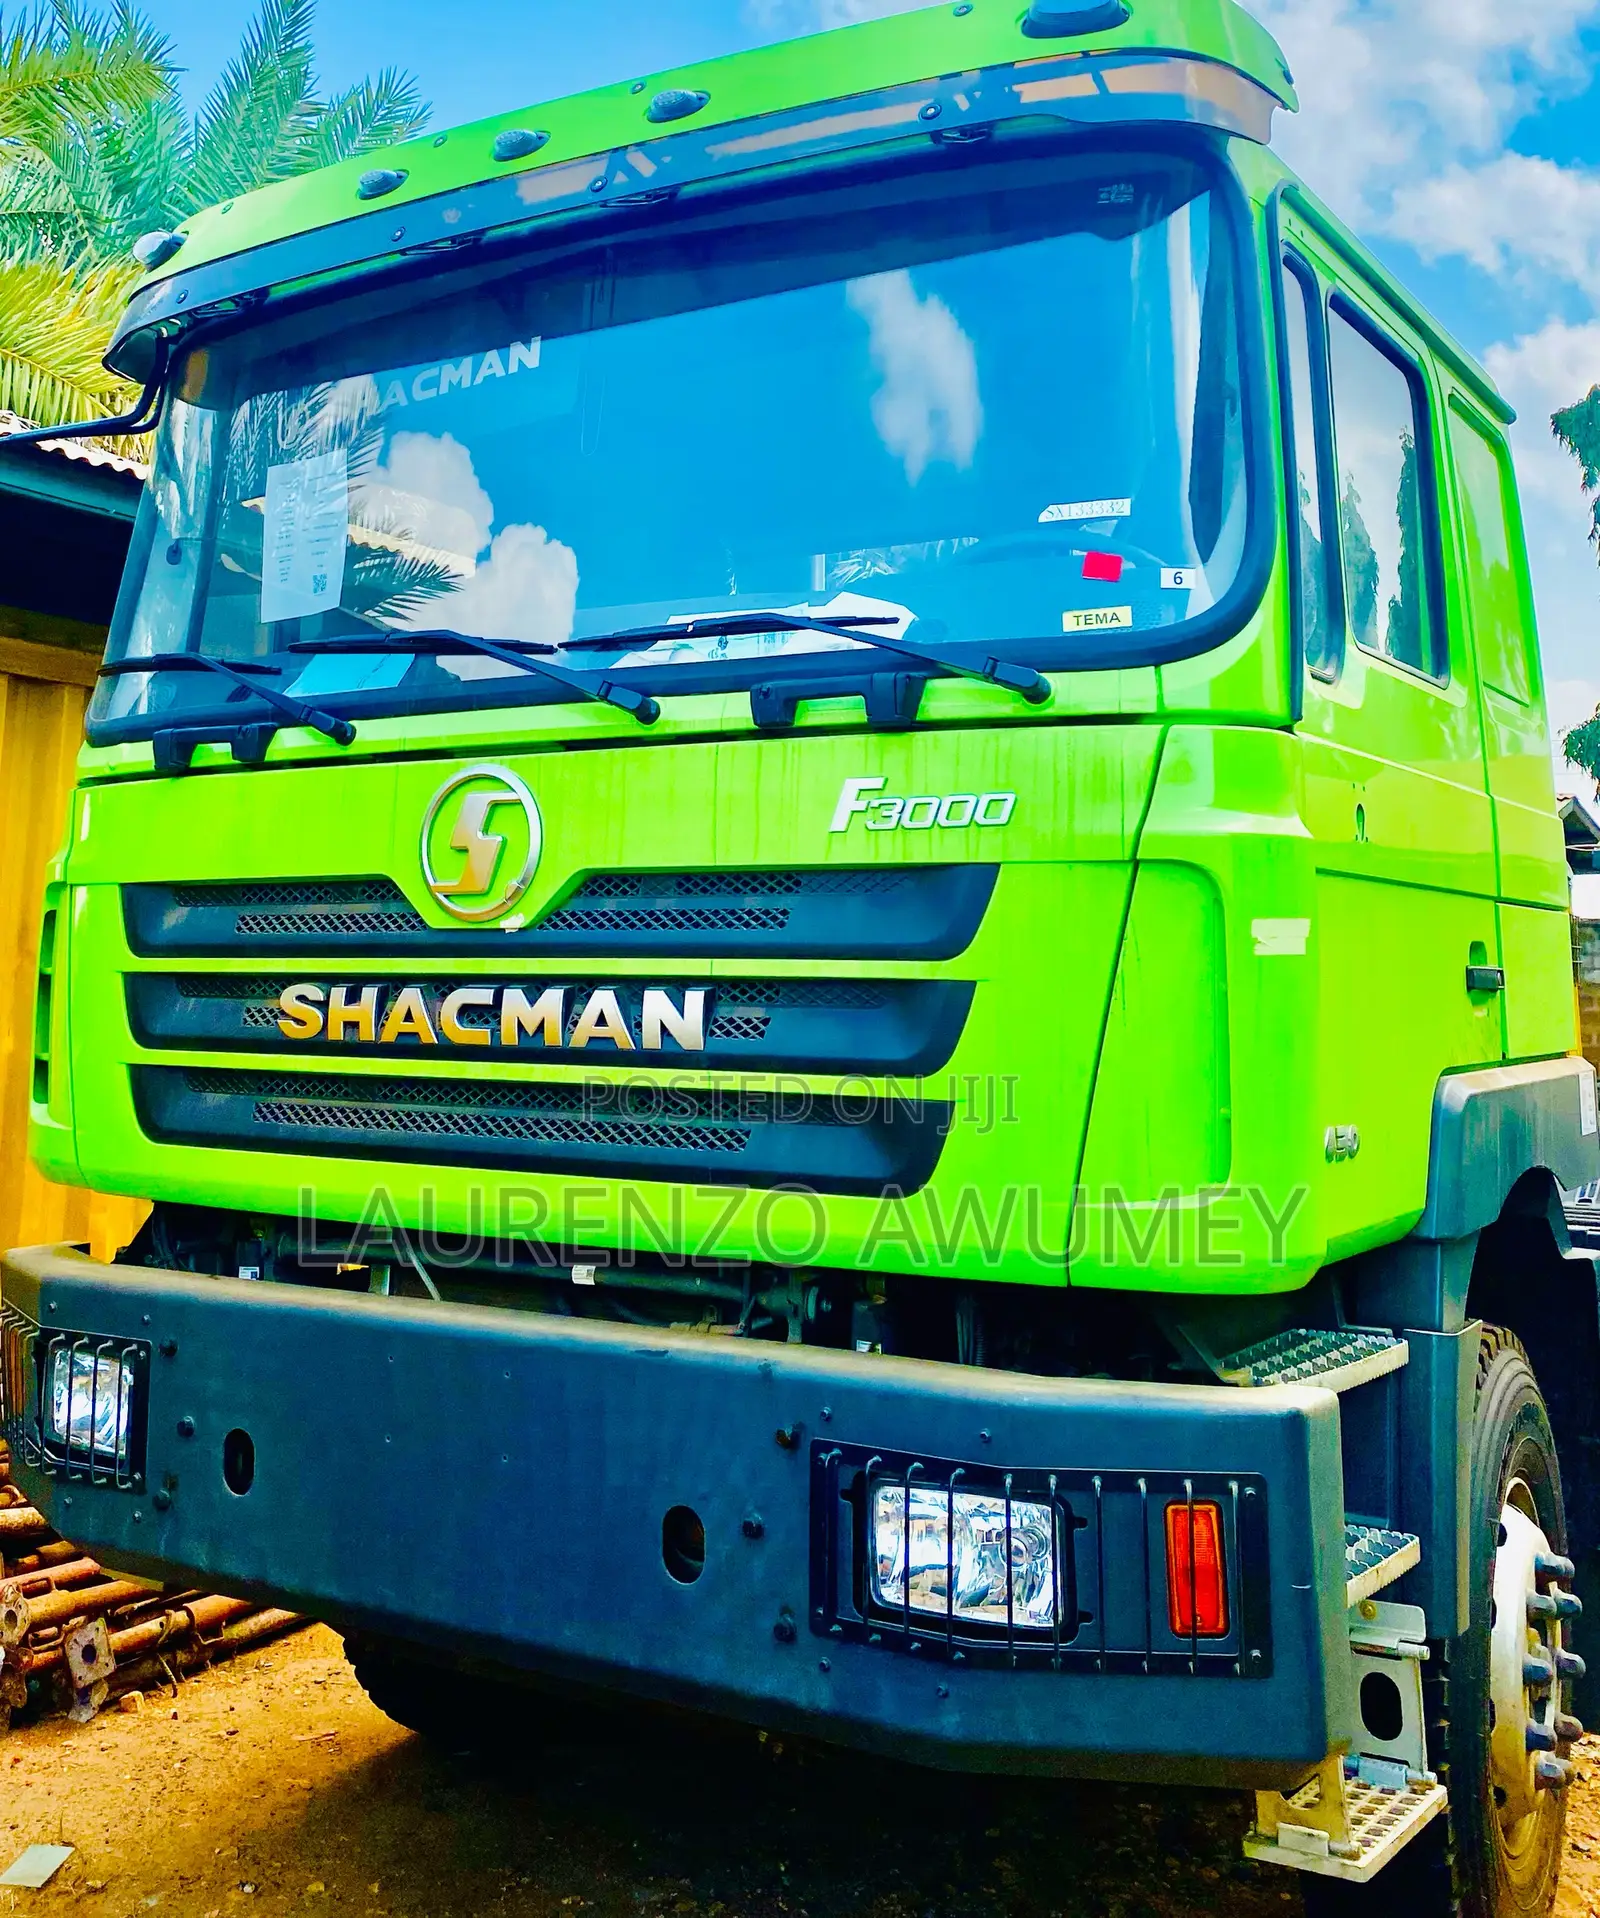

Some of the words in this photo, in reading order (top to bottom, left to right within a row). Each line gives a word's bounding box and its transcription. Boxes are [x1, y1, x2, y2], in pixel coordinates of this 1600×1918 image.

[1173, 571, 1184, 585] 6
[1073, 612, 1121, 626] TEMA
[829, 776, 1016, 832] F3000
[278, 984, 706, 1050] SHACMAN
